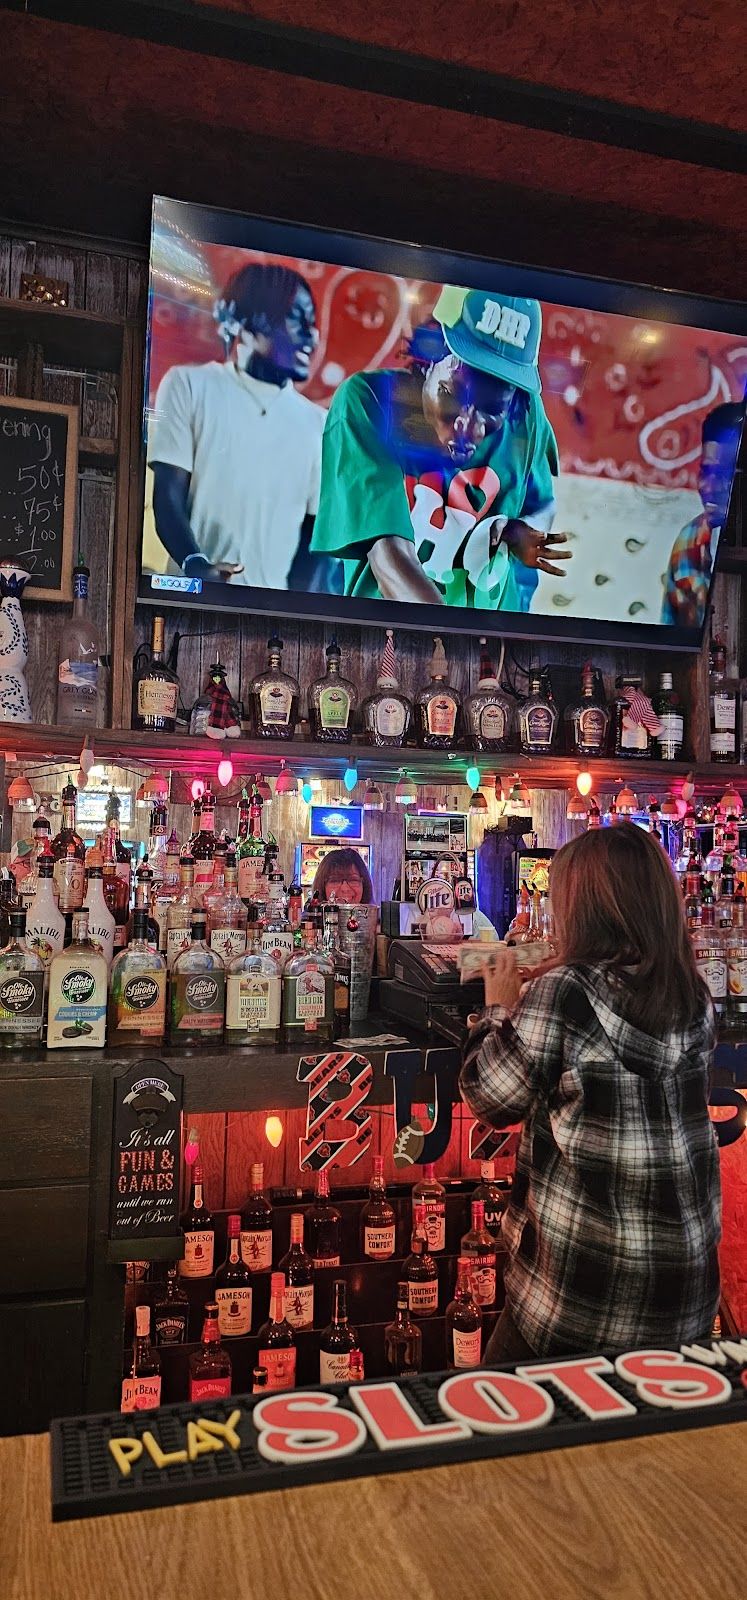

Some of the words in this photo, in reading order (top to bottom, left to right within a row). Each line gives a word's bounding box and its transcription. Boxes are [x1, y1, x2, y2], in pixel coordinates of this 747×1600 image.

[240, 860, 266, 870] JAMES
[25, 926, 60, 941] MALIBU
[87, 926, 111, 940] ALIBU
[62, 978, 96, 991] Smoky
[126, 982, 158, 996] Smoky
[186, 982, 217, 996] Smoky
[0, 985, 35, 999] Smoky
[118, 1129, 151, 1148] It's
[153, 1129, 175, 1147] all
[119, 1150, 156, 1173] FUN
[159, 1149, 175, 1170] &
[117, 1172, 175, 1194] GAMES
[116, 1195, 141, 1209] until
[140, 1199, 155, 1208] we
[155, 1197, 174, 1207] run
[116, 1213, 131, 1226] out
[131, 1213, 144, 1230] of
[143, 1208, 175, 1224] Beer
[185, 1235, 213, 1244] AMESON
[368, 1241, 393, 1249] COMFORT
[217, 1291, 251, 1301] JAMESON
[411, 1296, 436, 1305] COMFORT
[139, 1384, 159, 1398] BEAM
[108, 1409, 241, 1478] PLAY
[252, 1349, 732, 1466] SLOTS
